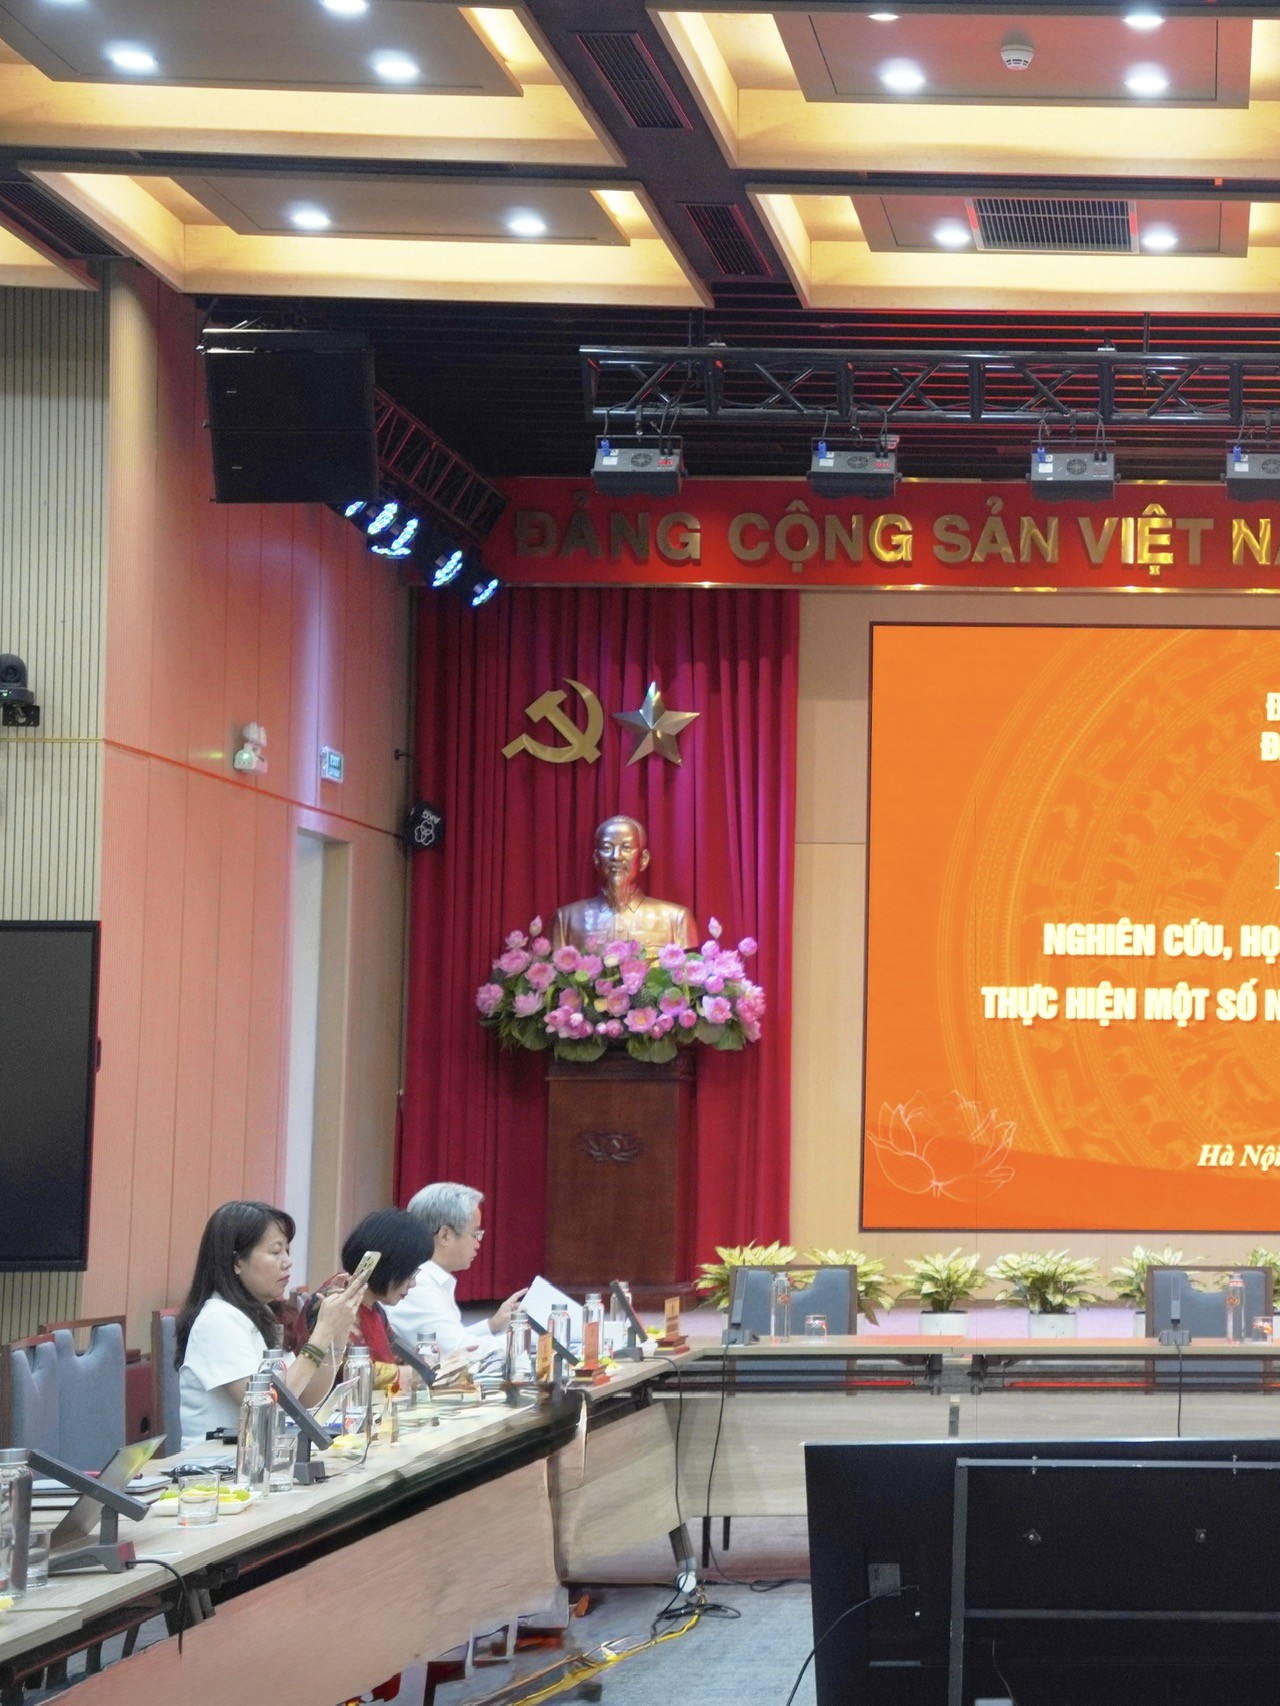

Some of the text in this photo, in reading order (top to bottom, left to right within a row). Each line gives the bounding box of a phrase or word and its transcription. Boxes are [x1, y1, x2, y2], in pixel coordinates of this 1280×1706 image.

[514, 490, 701, 560] ĐẢNG
[728, 500, 913, 574] CỘNG
[933, 497, 1059, 565] SẢN
[1077, 503, 1214, 576] VIỆT
[421, 809, 441, 824] AKG
[1043, 916, 1156, 957] NGHIÊN
[1162, 917, 1233, 961] CỨU,
[980, 983, 1059, 1026] THỰC
[1065, 980, 1137, 1027] HIỆN
[1143, 981, 1210, 1028] MỘT
[1215, 977, 1259, 1022] SỐ
[1197, 1144, 1234, 1167] Hà
